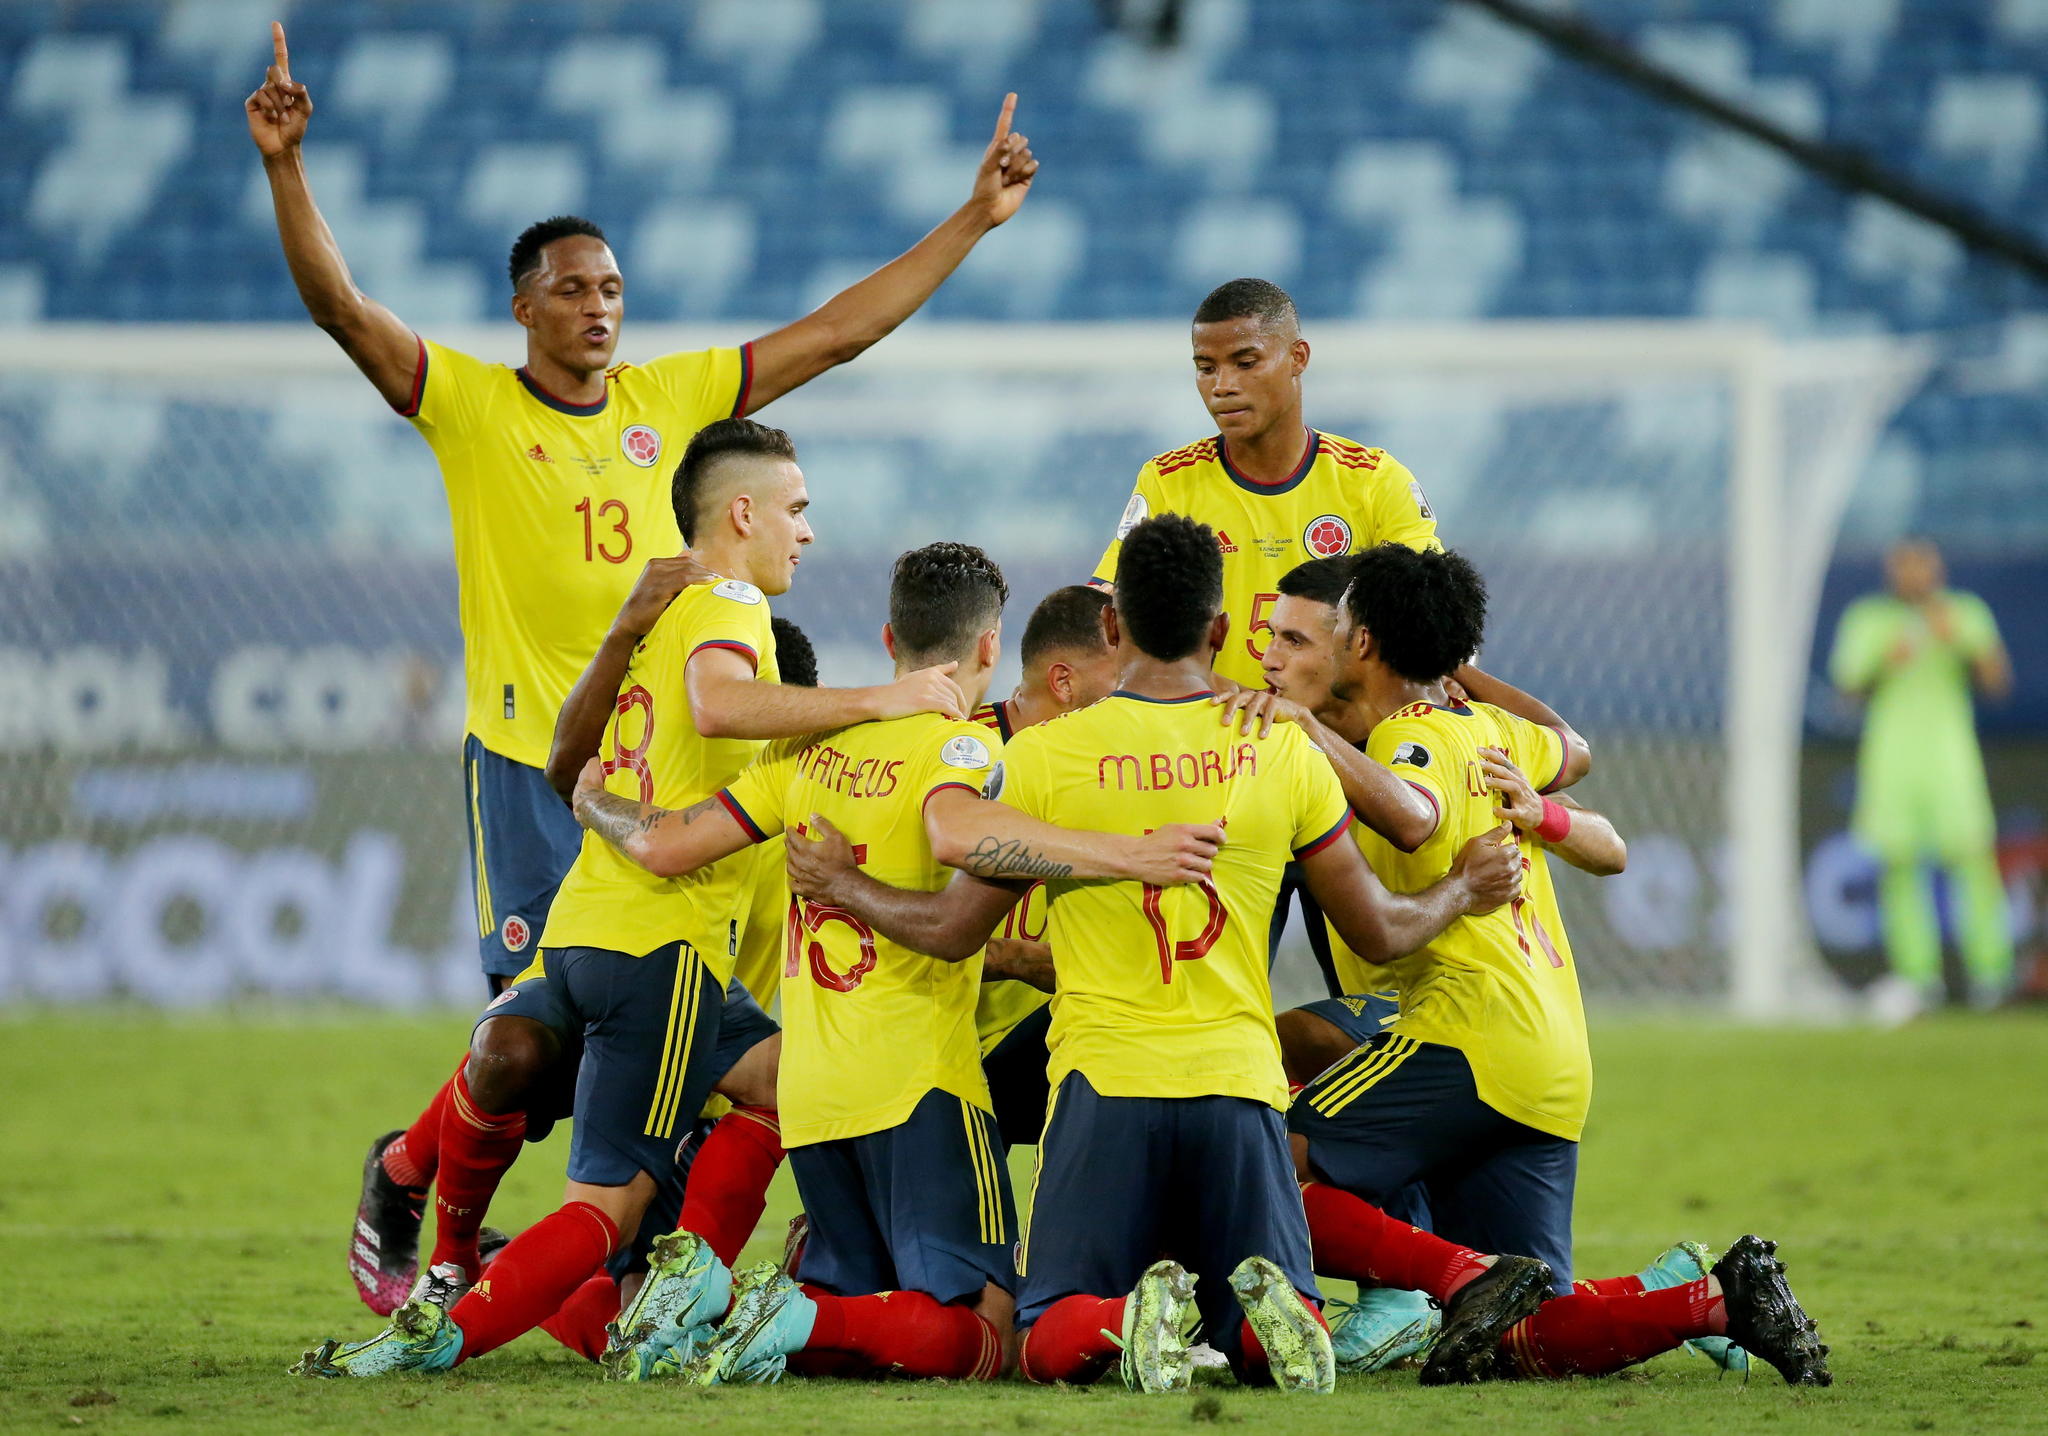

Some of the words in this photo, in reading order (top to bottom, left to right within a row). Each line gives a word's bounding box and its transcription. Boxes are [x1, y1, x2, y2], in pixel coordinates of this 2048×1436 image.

[575, 496, 633, 564] 13
[1247, 593, 1280, 661] 5
[1099, 743, 1257, 791] M.BORJA
